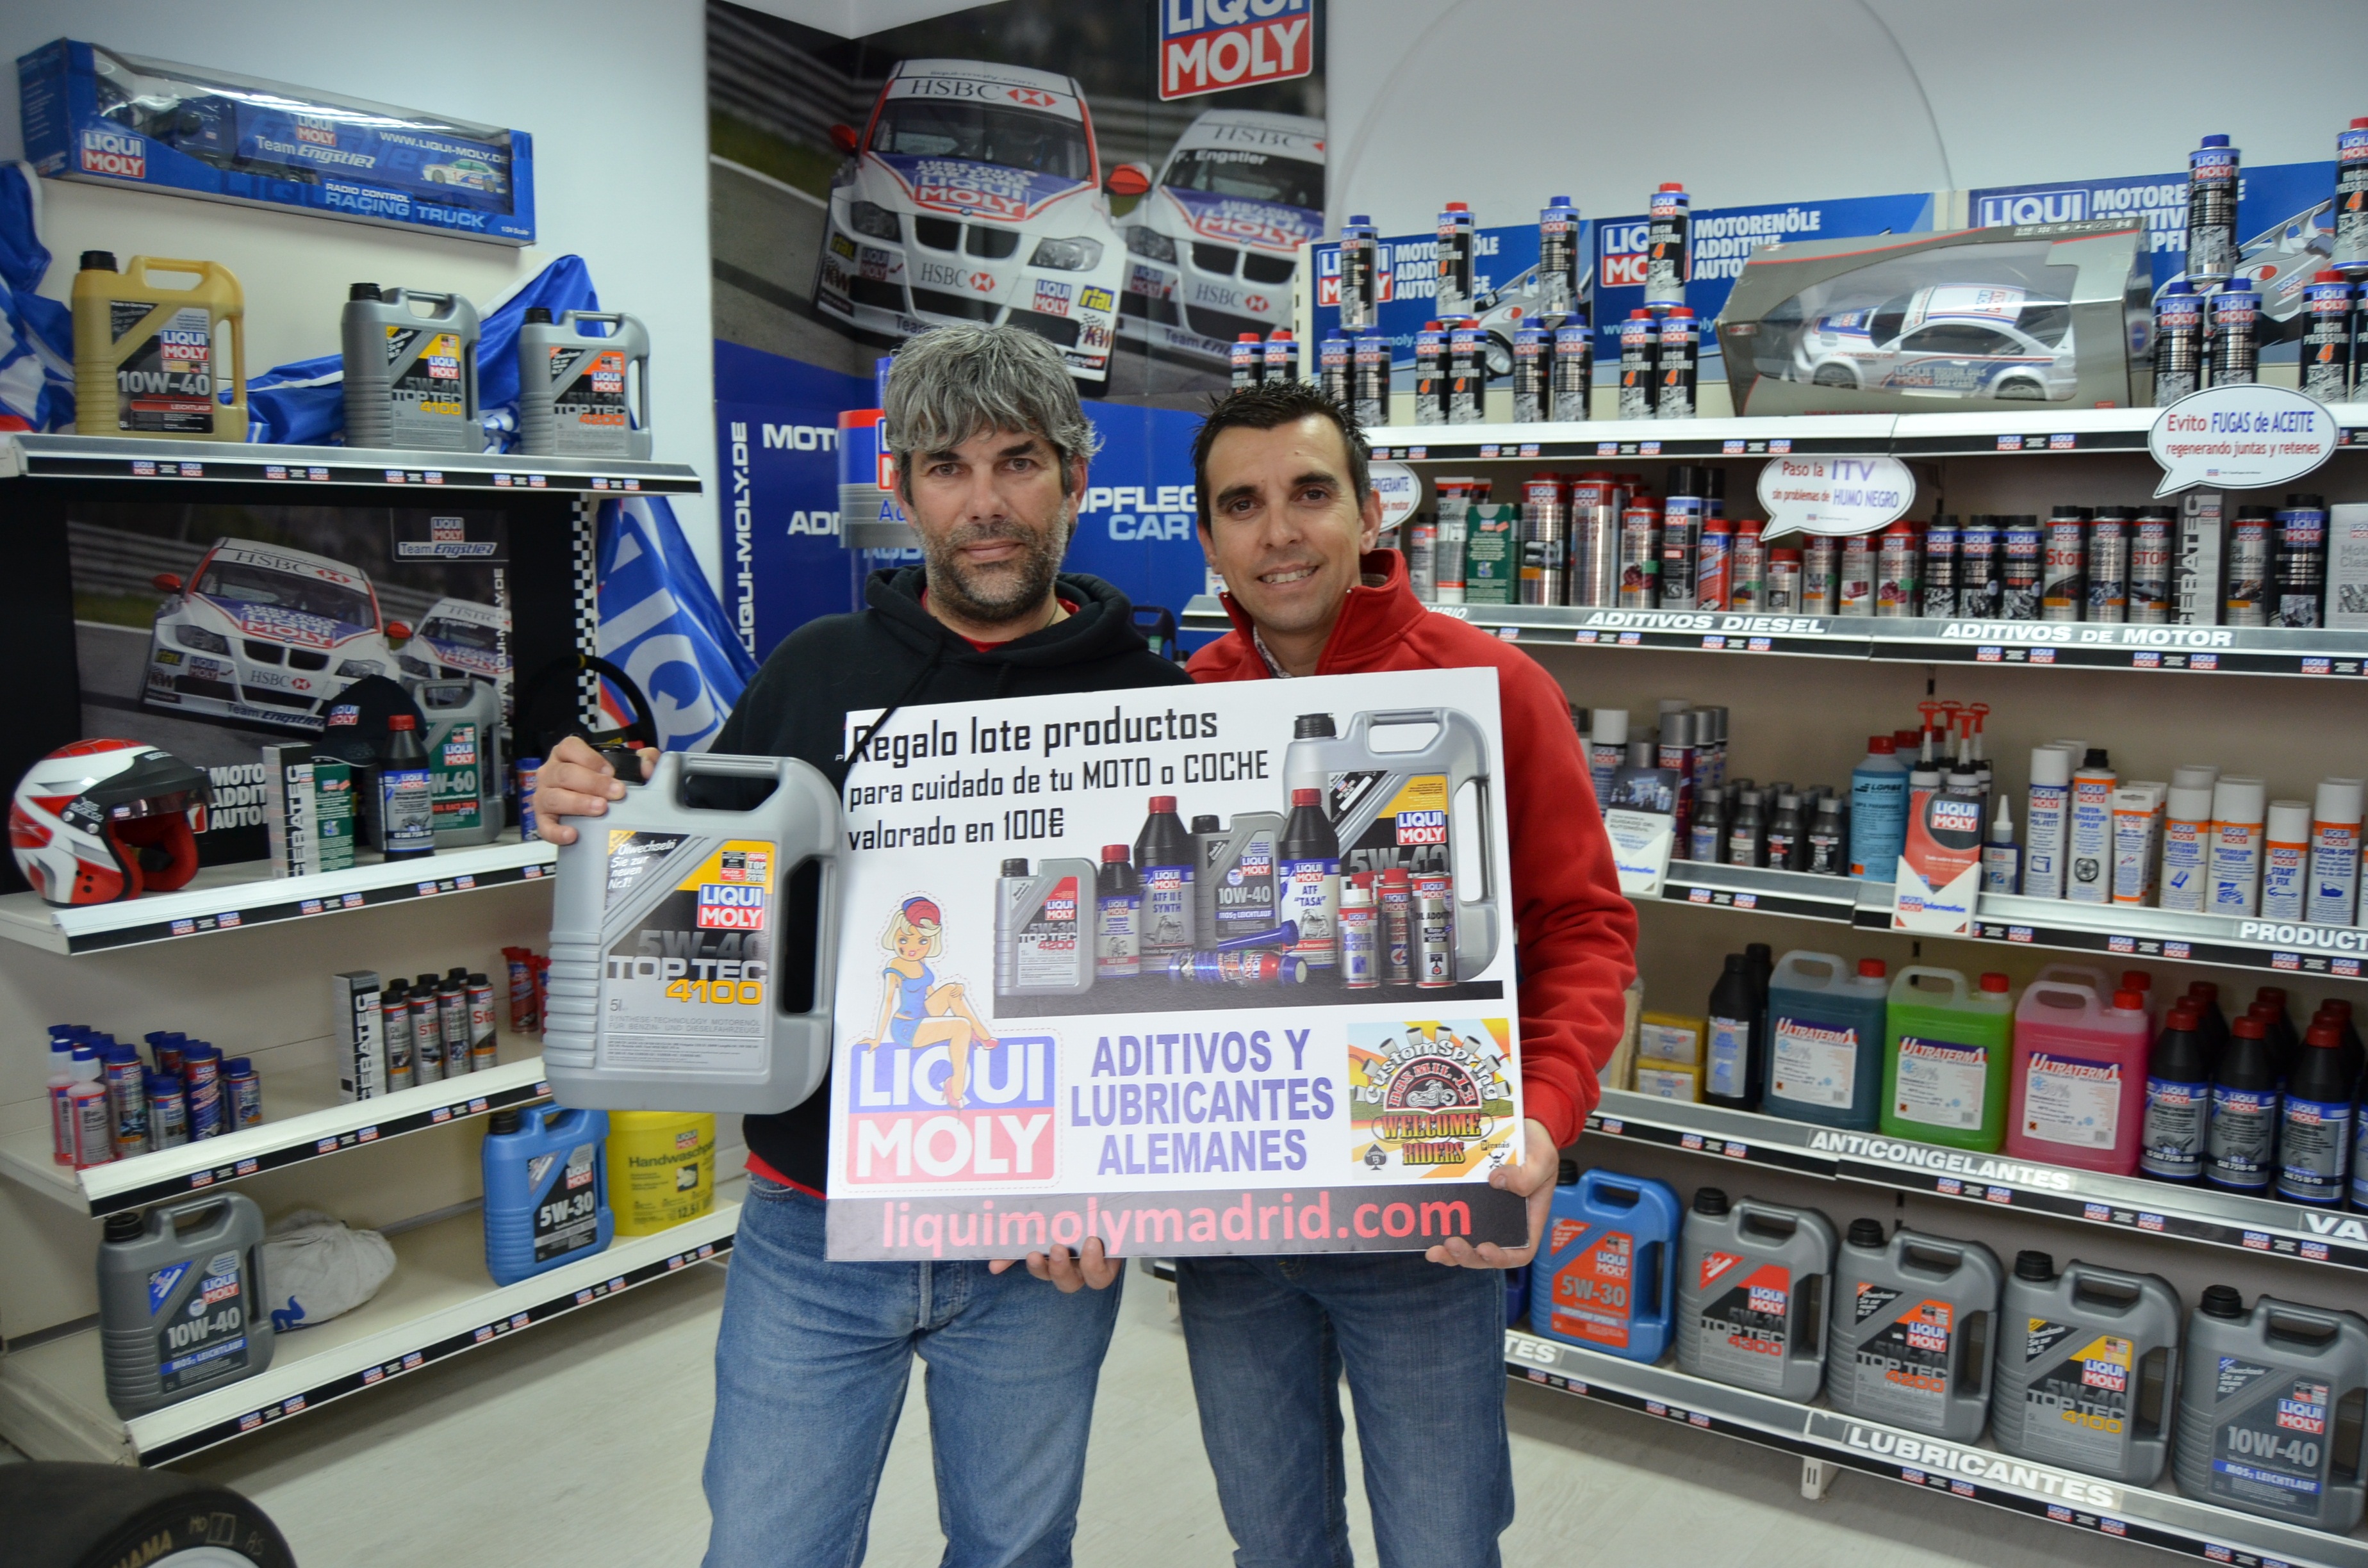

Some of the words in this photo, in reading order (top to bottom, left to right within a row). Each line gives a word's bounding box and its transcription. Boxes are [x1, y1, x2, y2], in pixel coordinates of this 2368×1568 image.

[1168, 19, 1307, 92] MOLY
[910, 79, 999, 101] HSBC
[84, 131, 141, 158] LIQUI
[255, 135, 295, 155] Team
[1215, 127, 1304, 149] HSBC
[83, 151, 143, 177] MOLY
[1194, 151, 1269, 165] Engstler
[2195, 156, 2229, 167] LIQUI
[2195, 167, 2232, 178] MOLY
[325, 183, 359, 197] RADIO
[361, 187, 411, 204] CONTROL
[2345, 191, 2364, 212] 4
[325, 191, 411, 218] RACING
[416, 205, 486, 229] TRUCK
[1984, 194, 2085, 226] LIQUI
[1651, 224, 1673, 234] HIGH
[1695, 206, 1821, 240] MOTORENÖLE
[1652, 243, 1665, 259] 4
[921, 263, 967, 288] HSBC
[1037, 281, 1072, 299] LIQUI
[1196, 282, 1242, 308] HSBC
[1035, 297, 1069, 316] MOLY
[163, 331, 206, 345] LIQUI
[2314, 323, 2342, 334] HIGH
[163, 347, 208, 359] MOLY
[2315, 343, 2335, 363] 4
[117, 371, 211, 395] 10W-40
[1624, 371, 1636, 387] 4
[1665, 370, 1679, 386] 4
[392, 389, 431, 402] TOP
[431, 391, 462, 403] TEC
[170, 403, 211, 411] LEICHTLAUF
[420, 401, 461, 415] 4100
[579, 414, 625, 425] 4200
[2167, 413, 2208, 432] Evito
[2210, 411, 2252, 434] FUGAS
[2254, 411, 2270, 434] de
[2271, 410, 2315, 434] ACEITE
[2166, 440, 2232, 458] regenerando
[2232, 441, 2267, 458] juntas
[2268, 443, 2277, 458] y
[2278, 441, 2321, 455] retenes
[1782, 460, 1809, 477] Paso
[1813, 462, 1824, 477] la
[1832, 459, 1877, 482] ITV
[1772, 487, 1783, 502] sin
[1783, 489, 1820, 503] problemas
[1821, 489, 1830, 502] de
[1832, 488, 1862, 507] HUMO
[1864, 490, 1900, 509] NEGRO
[1108, 514, 1190, 541] CAR
[401, 543, 433, 555] Team
[2132, 551, 2169, 565] STOP
[236, 552, 315, 574] HSBC
[1584, 610, 1713, 630] ADITIVOS
[1720, 616, 1827, 633] DIESEL
[1941, 623, 2073, 642] ADITIVOS
[2080, 628, 2114, 642] DE
[2121, 628, 2233, 646] MOTOR
[250, 670, 289, 688] HSBC
[852, 718, 958, 770] Regalo
[970, 715, 1032, 756] lote
[1044, 705, 1219, 758] productos
[850, 783, 903, 813] para
[911, 768, 1004, 801] cuidado
[1012, 765, 1040, 794] de
[1049, 769, 1073, 792] tu
[1083, 756, 1151, 790] MOTO
[1160, 764, 1175, 785] o
[1183, 749, 1270, 785] COCHE
[1399, 811, 1444, 827] LIQUI
[1935, 801, 1978, 818] LIQUI
[848, 815, 957, 851] valorado
[964, 819, 994, 845] en
[1003, 807, 1065, 842] 100€
[1934, 816, 1977, 831] MOLY
[1399, 827, 1445, 844] MOLY
[611, 857, 629, 869] Sie
[1242, 856, 1269, 866] LIQUI
[1295, 863, 1323, 872] LIQUI
[1349, 844, 1450, 872] 5W-40
[611, 867, 643, 878] neuen
[1154, 871, 1180, 880] LIQUI
[1242, 865, 1270, 876] MOLY
[1295, 872, 1324, 882] MOLY
[2271, 867, 2296, 876] START
[1154, 880, 1180, 889] MOLY
[1302, 885, 1318, 895] ATF
[2276, 876, 2290, 886] FIX
[701, 886, 762, 908] LIQUI
[1046, 900, 1074, 910] LIQUI
[1217, 886, 1272, 904] 10W-40
[700, 908, 762, 927] MOLY
[1046, 910, 1075, 919] MOLY
[1153, 903, 1181, 913] SYNTH
[1237, 910, 1272, 919] LEICHTLAUF
[1018, 933, 1048, 943] TOP
[1049, 933, 1078, 942] TEC
[1028, 922, 1076, 934] 5W-30
[637, 930, 769, 960] 5W-40
[1037, 940, 1075, 951] 4200
[607, 955, 688, 981] TOP
[691, 958, 768, 984] TEC
[665, 979, 764, 1006] 4100
[609, 1015, 707, 1026] SYNTHESE-TECHNOLOGY
[711, 1017, 761, 1027] MOTORENÖL
[609, 1022, 625, 1031] FÜR
[629, 1023, 661, 1032] BENZIN-
[664, 1024, 682, 1033] UND
[686, 1024, 762, 1035] DIESELFAHRZEUGE
[1090, 1029, 1273, 1078] ADITIVOS
[1283, 1028, 1312, 1071] Y
[860, 1043, 1044, 1109] LIQUI
[1071, 1077, 1335, 1127] LUBRICANTES
[1380, 1113, 1483, 1141] WELCOME
[857, 1115, 1052, 1177] MOLY
[1097, 1128, 1308, 1176] ALEMANES
[1402, 1141, 1467, 1166] RIDERS
[1809, 1131, 2070, 1191] ANTICONGELANTES
[540, 1191, 595, 1227] 5W-30
[882, 1191, 1472, 1259] liquimolymadrid.com
[1559, 1275, 1627, 1308] 5W-30
[168, 1307, 242, 1350] 10W-40
[1741, 1323, 1786, 1344] TEC
[1727, 1335, 1784, 1357] 4300
[1901, 1359, 1948, 1380] TEC
[1885, 1369, 1945, 1393] 4200
[2027, 1389, 2076, 1412] TOP
[2074, 1400, 2126, 1421] TEC
[2281, 1401, 2326, 1419] LIQUI
[2060, 1410, 2123, 1434] 4100
[2279, 1413, 2324, 1433] MOLY
[2228, 1426, 2320, 1468] 10W-40
[1848, 1426, 2114, 1507] LUBRICANTES
[2256, 1469, 2318, 1492] LEICHTLAUF
